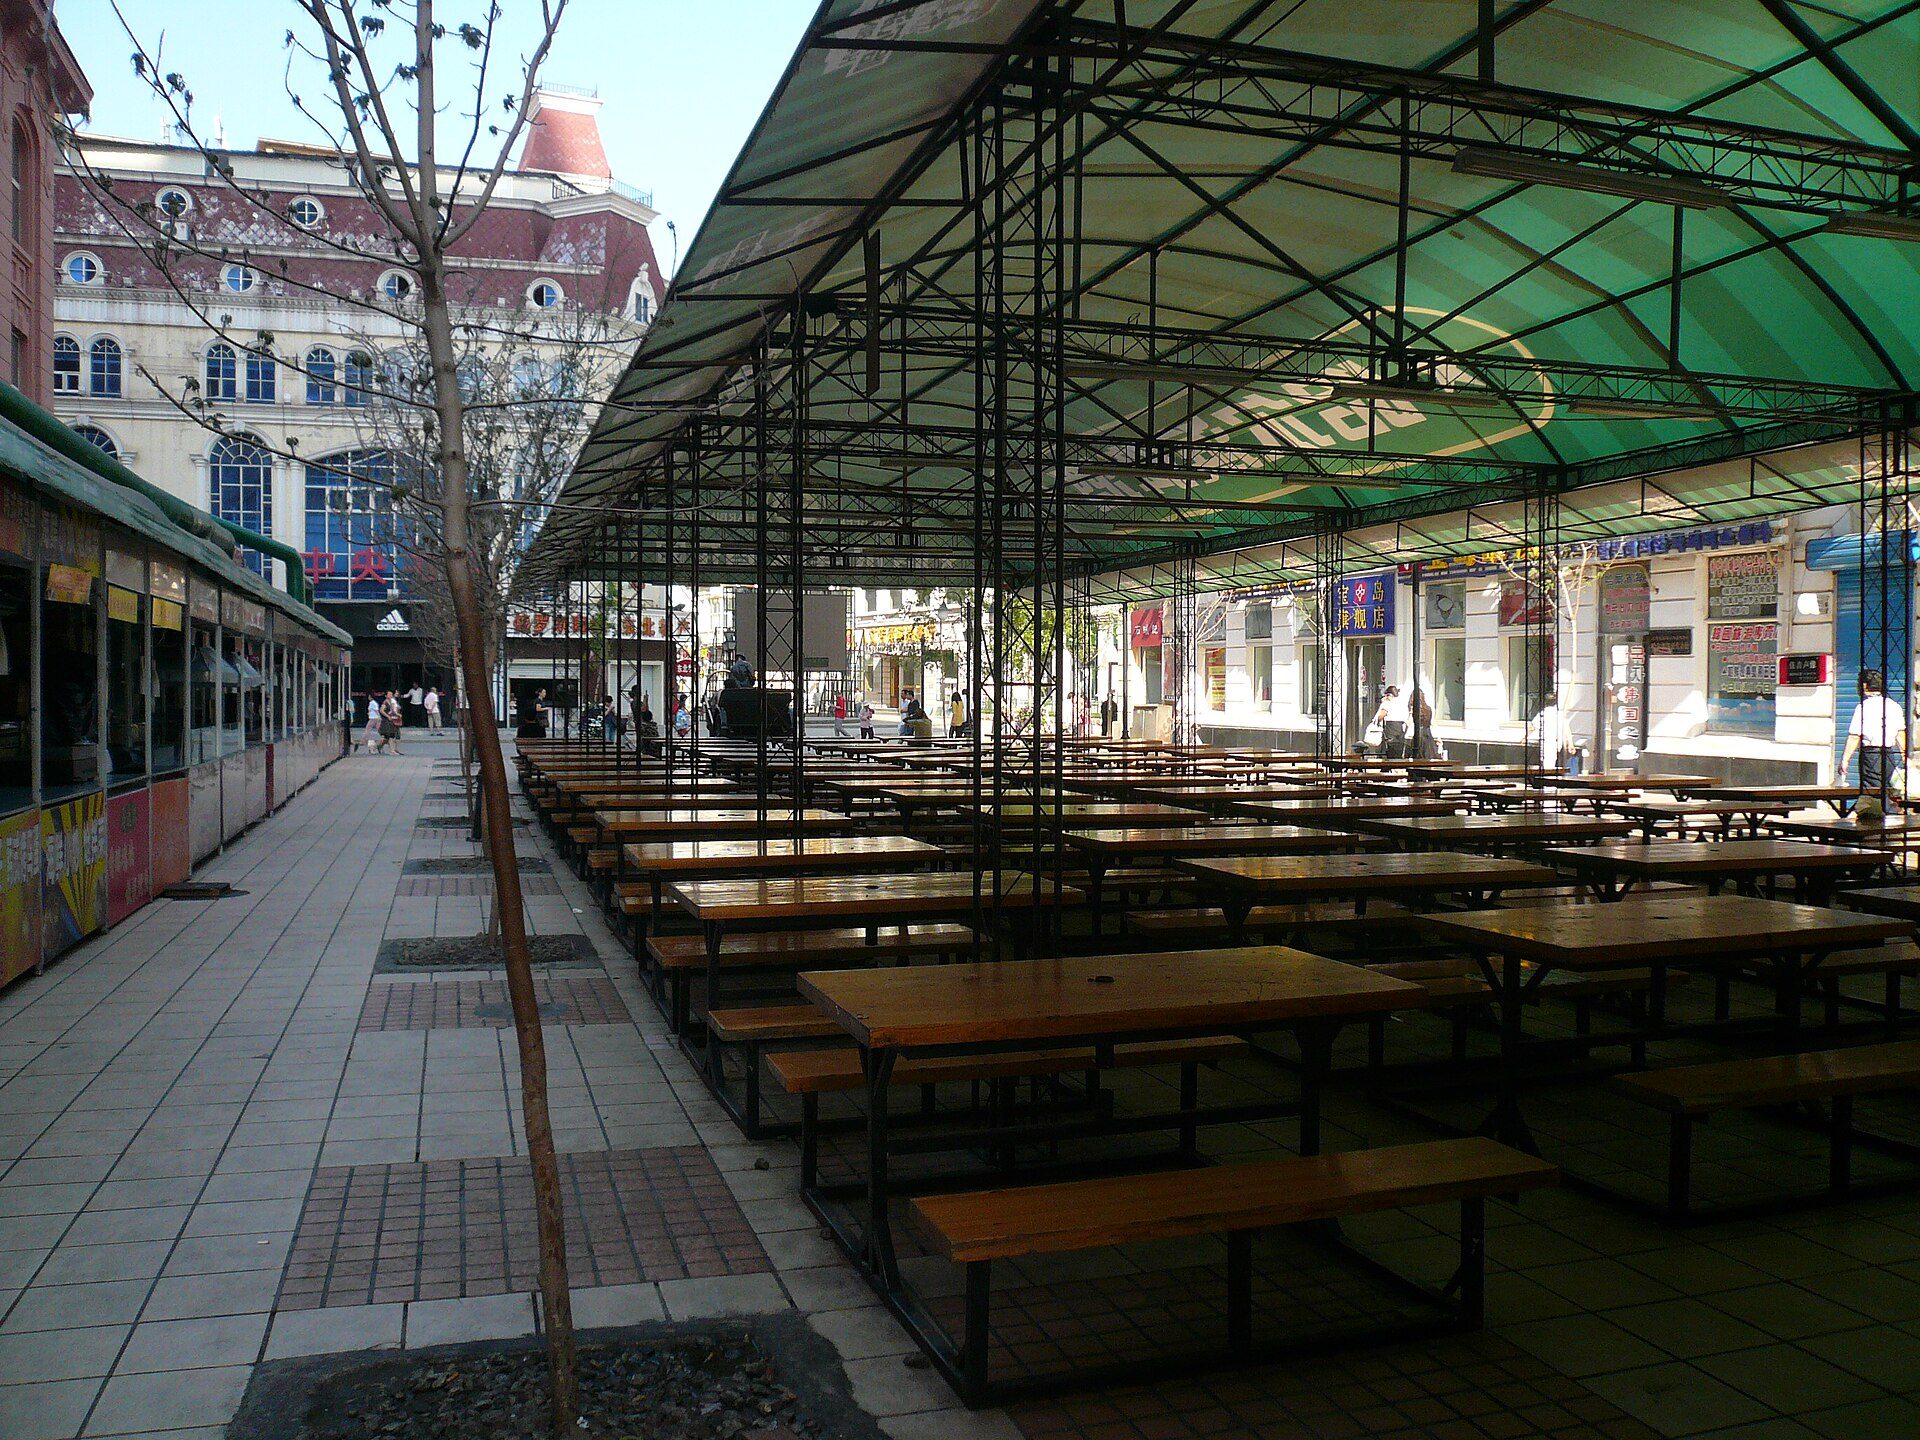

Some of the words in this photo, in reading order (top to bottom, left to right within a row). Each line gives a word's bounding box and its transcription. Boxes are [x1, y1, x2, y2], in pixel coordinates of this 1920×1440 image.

[376, 623, 410, 631] adidas
[1337, 606, 1385, 630] 旗舰店
[1616, 686, 1640, 761] 韩国之
